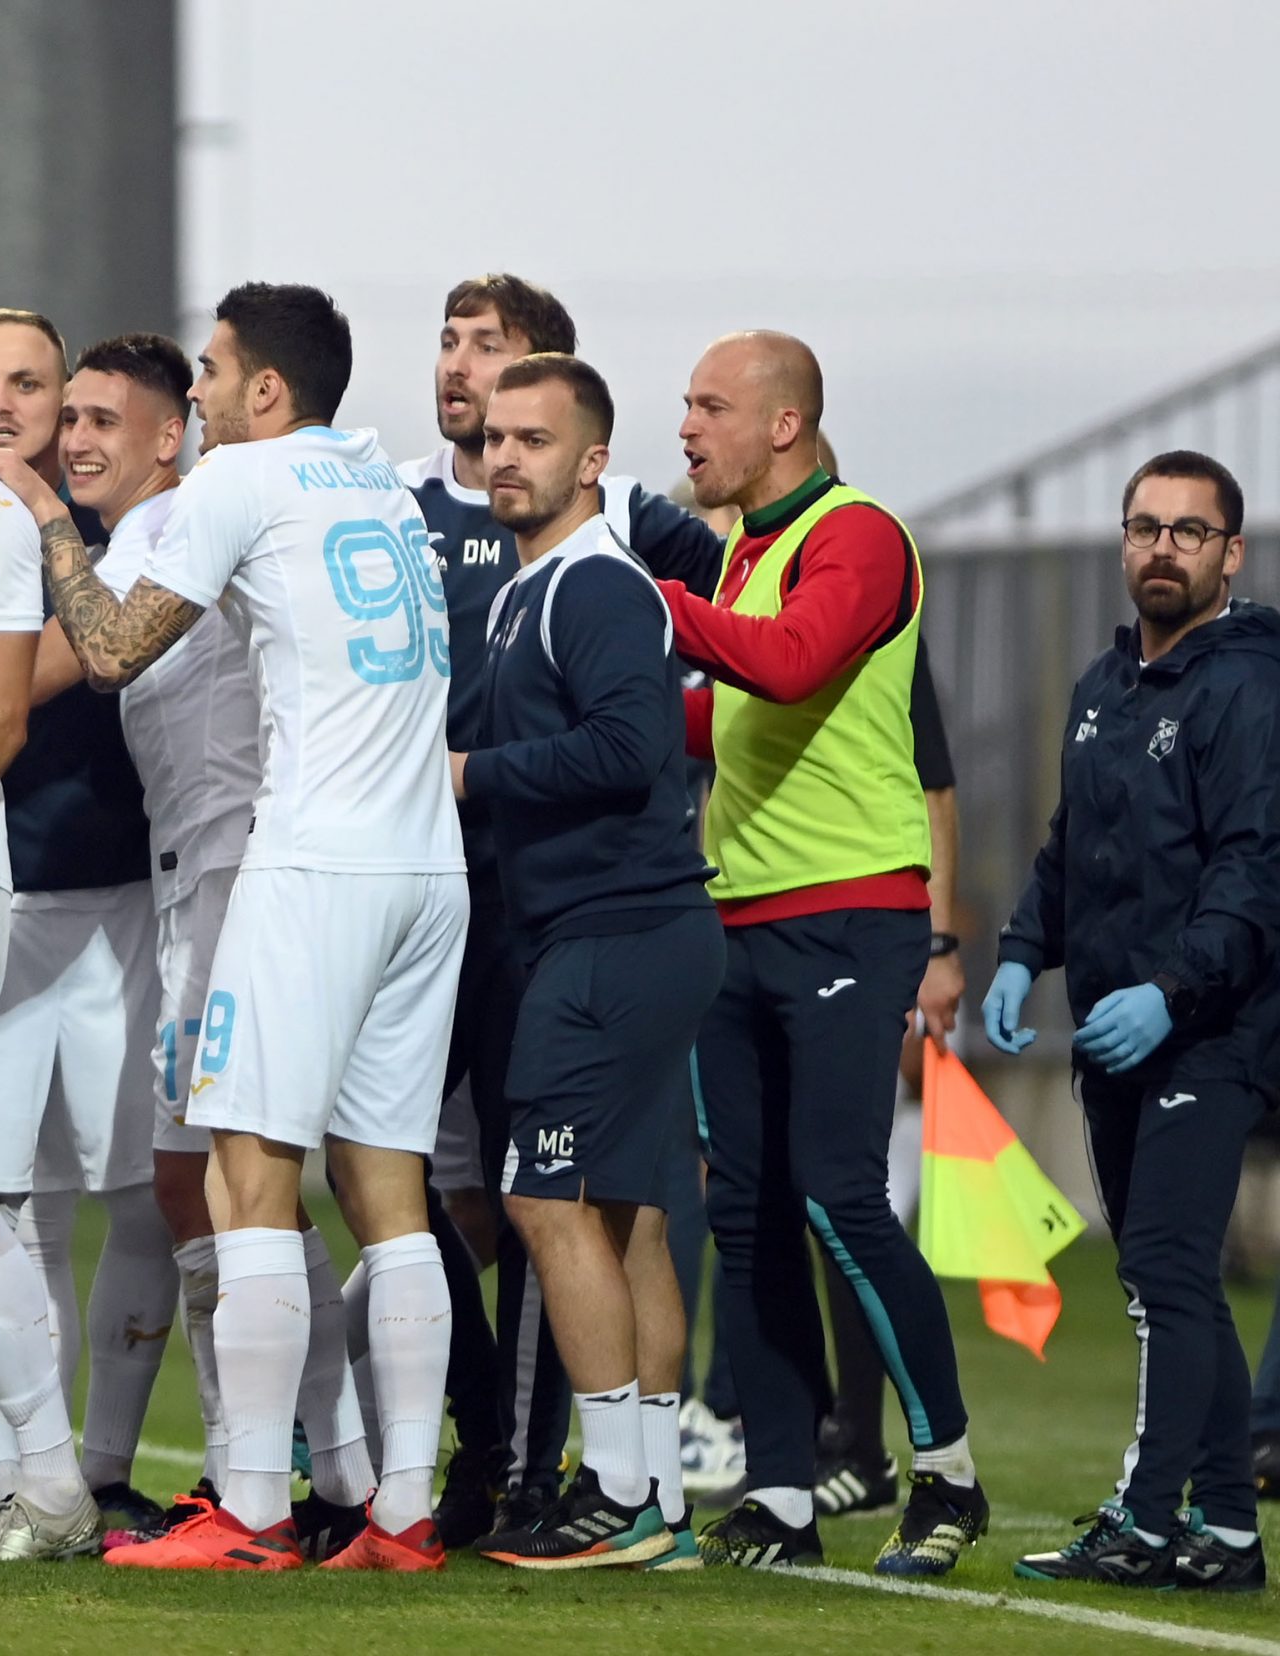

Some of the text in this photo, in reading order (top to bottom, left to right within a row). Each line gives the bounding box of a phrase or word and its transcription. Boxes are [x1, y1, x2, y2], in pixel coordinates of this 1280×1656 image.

[463, 538, 501, 565] DM
[200, 990, 236, 1074] 9
[538, 1125, 575, 1157] MČ
